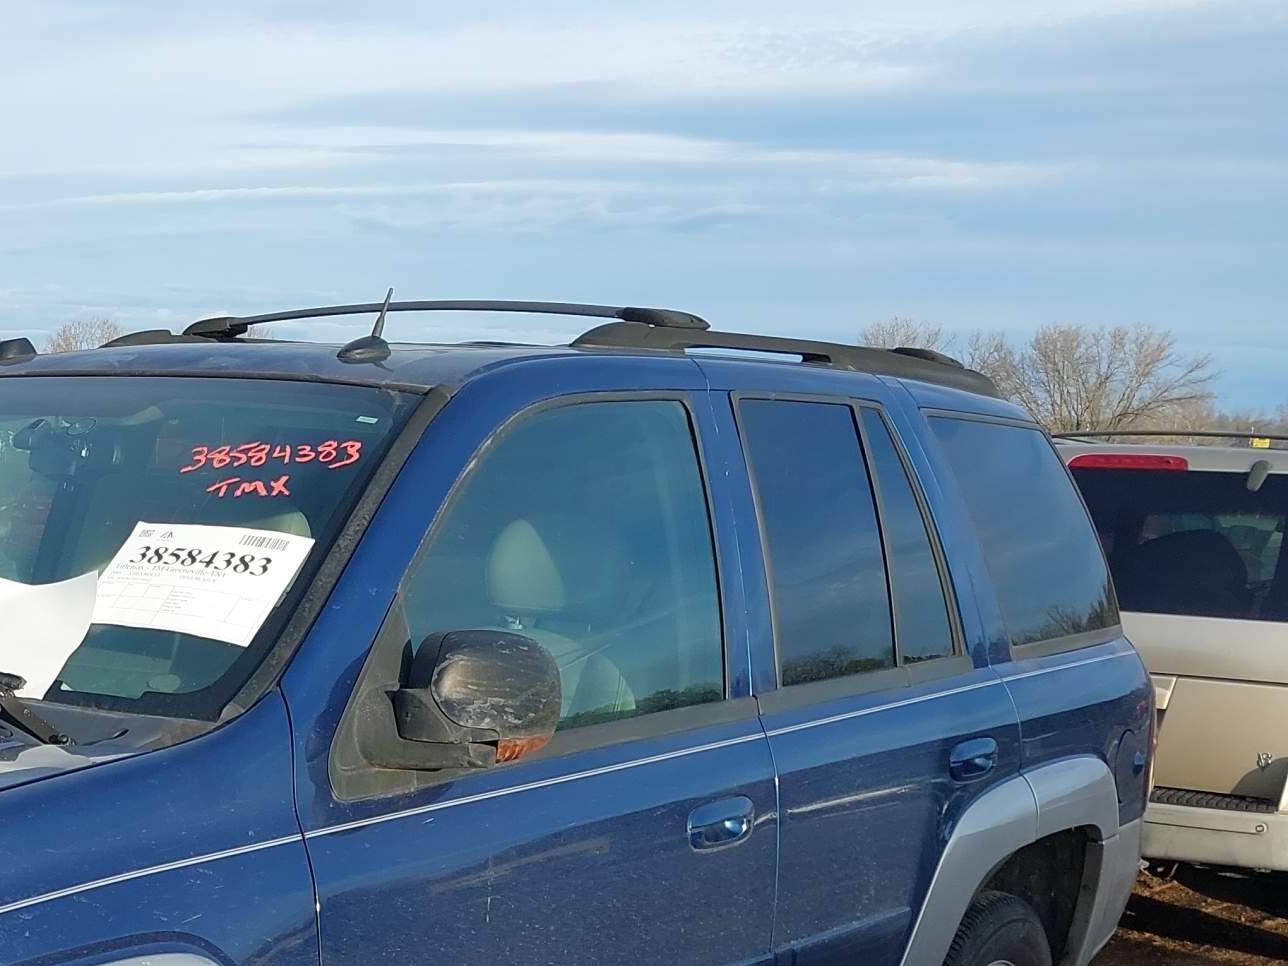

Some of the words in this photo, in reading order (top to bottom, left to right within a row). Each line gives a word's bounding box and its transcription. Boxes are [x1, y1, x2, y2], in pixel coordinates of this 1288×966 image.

[179, 440, 362, 473] 38584383
[206, 474, 291, 498] TMX
[129, 545, 272, 577] 38584383
